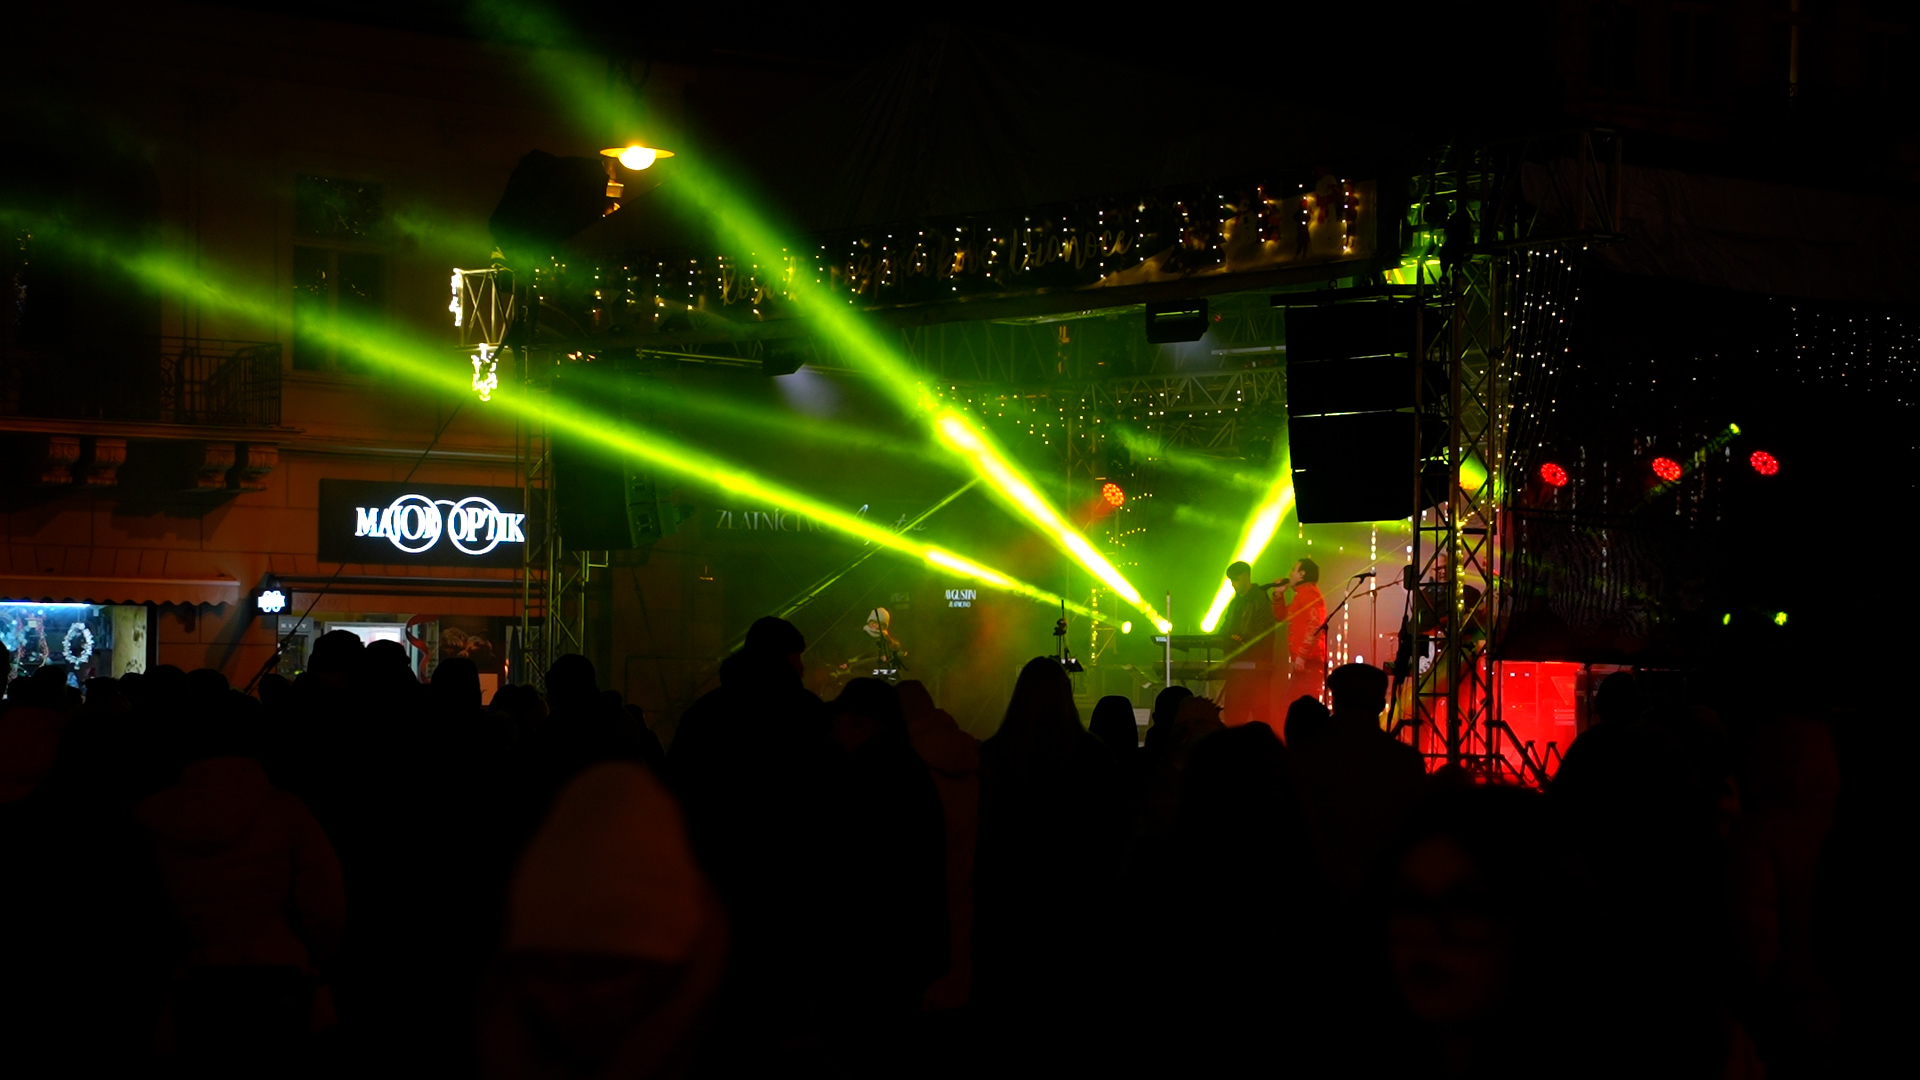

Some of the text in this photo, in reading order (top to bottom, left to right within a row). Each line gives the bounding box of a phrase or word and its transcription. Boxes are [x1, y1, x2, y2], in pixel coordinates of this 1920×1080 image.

[1008, 228, 1133, 275] Vianoce
[355, 505, 525, 543] MAJOR OPTIK
